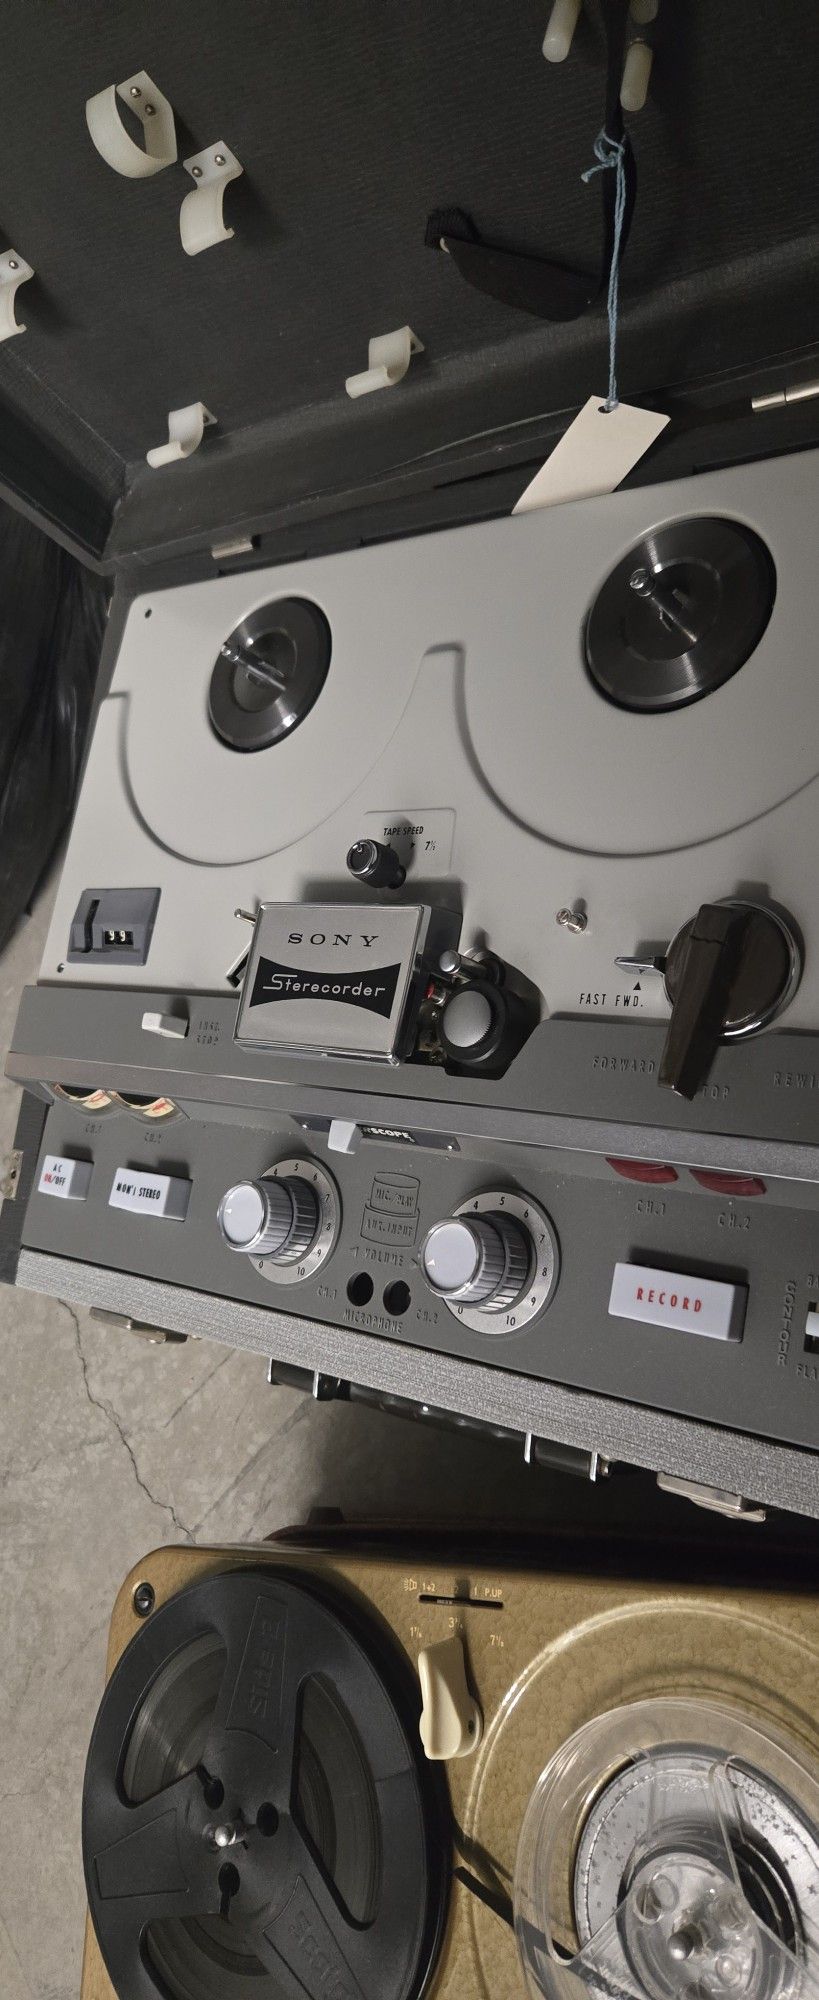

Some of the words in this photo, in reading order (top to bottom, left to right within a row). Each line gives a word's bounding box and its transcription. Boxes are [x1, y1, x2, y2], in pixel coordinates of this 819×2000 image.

[383, 827, 401, 836] TAPE
[403, 825, 424, 836] SPEED
[288, 932, 379, 948] SONY
[262, 973, 386, 997] Sterecorder
[579, 993, 607, 1006] FAST
[615, 994, 644, 1008] FWD.
[592, 1056, 656, 1074] FORWARD
[773, 1071, 819, 1088] REWI
[700, 1083, 730, 1100] TOP
[139, 1187, 161, 1200] STEREO
[636, 1199, 666, 1216] CH.1
[718, 1212, 751, 1230] CH.2
[365, 1247, 404, 1267] VOLUME
[297, 1266, 306, 1276] 10
[636, 1287, 703, 1313] RECORD
[342, 1307, 404, 1334] MICROPHONE
[505, 1315, 516, 1327] 10
[777, 1280, 797, 1367] CONTOUR
[484, 1587, 503, 1598] P.UP
